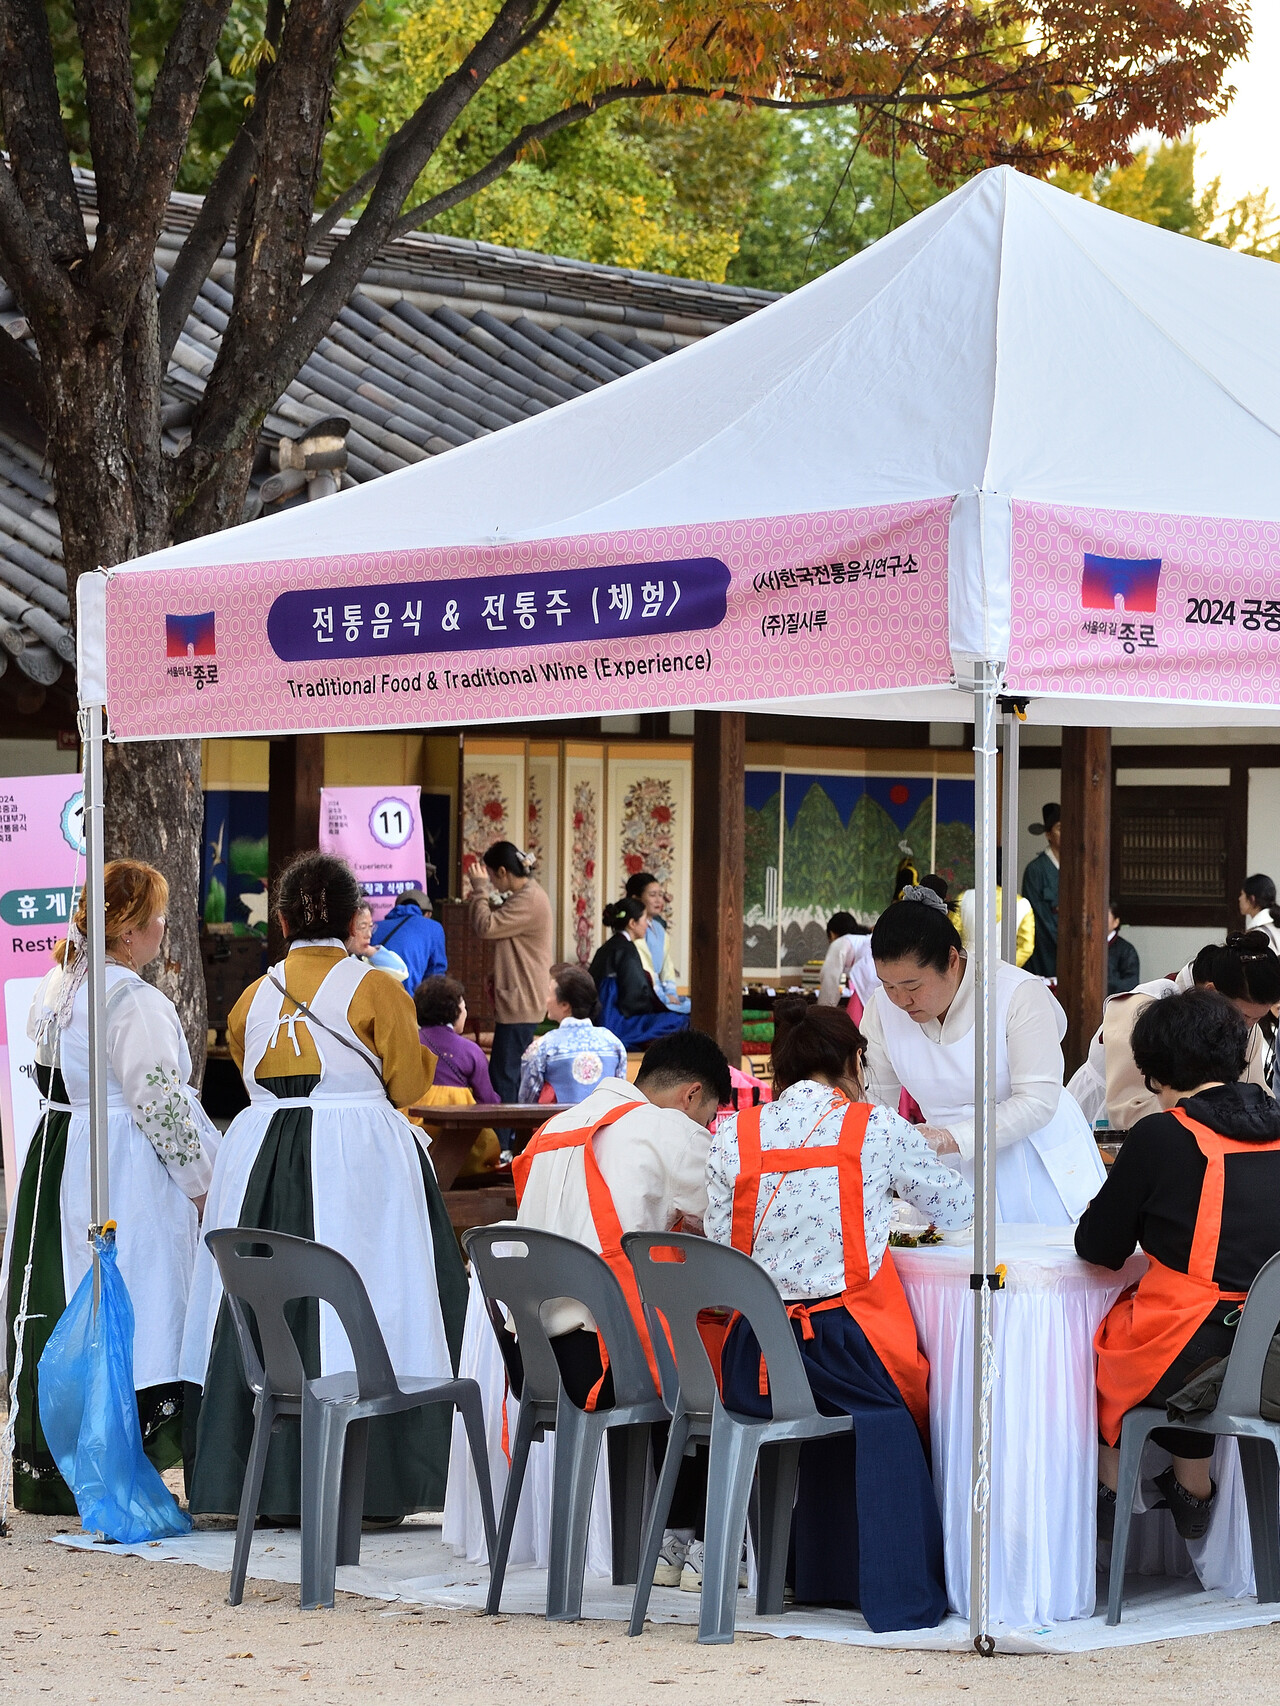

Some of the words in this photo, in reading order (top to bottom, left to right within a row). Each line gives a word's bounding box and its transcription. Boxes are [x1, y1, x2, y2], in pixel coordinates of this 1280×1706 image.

[753, 554, 919, 593] (사)한국전통음식연구소
[312, 600, 422, 643] 전통음식
[441, 599, 461, 632] &
[481, 589, 571, 631] 전통주
[592, 580, 681, 625] (체험)
[761, 610, 828, 637] (주)질시루
[1185, 598, 1236, 626] 2024
[1117, 622, 1159, 654] 종로
[193, 664, 219, 690] 종로
[287, 674, 377, 698] Traditional
[381, 671, 422, 694] Food
[427, 670, 438, 691] &
[444, 664, 538, 690] Traditional
[539, 661, 588, 683] Wine
[594, 648, 712, 681] (Experience)
[0, 805, 18, 813] 중과
[0, 813, 27, 823] 대부가
[379, 811, 402, 834] 11
[354, 863, 393, 871] Experience
[12, 936, 57, 953] Resti
